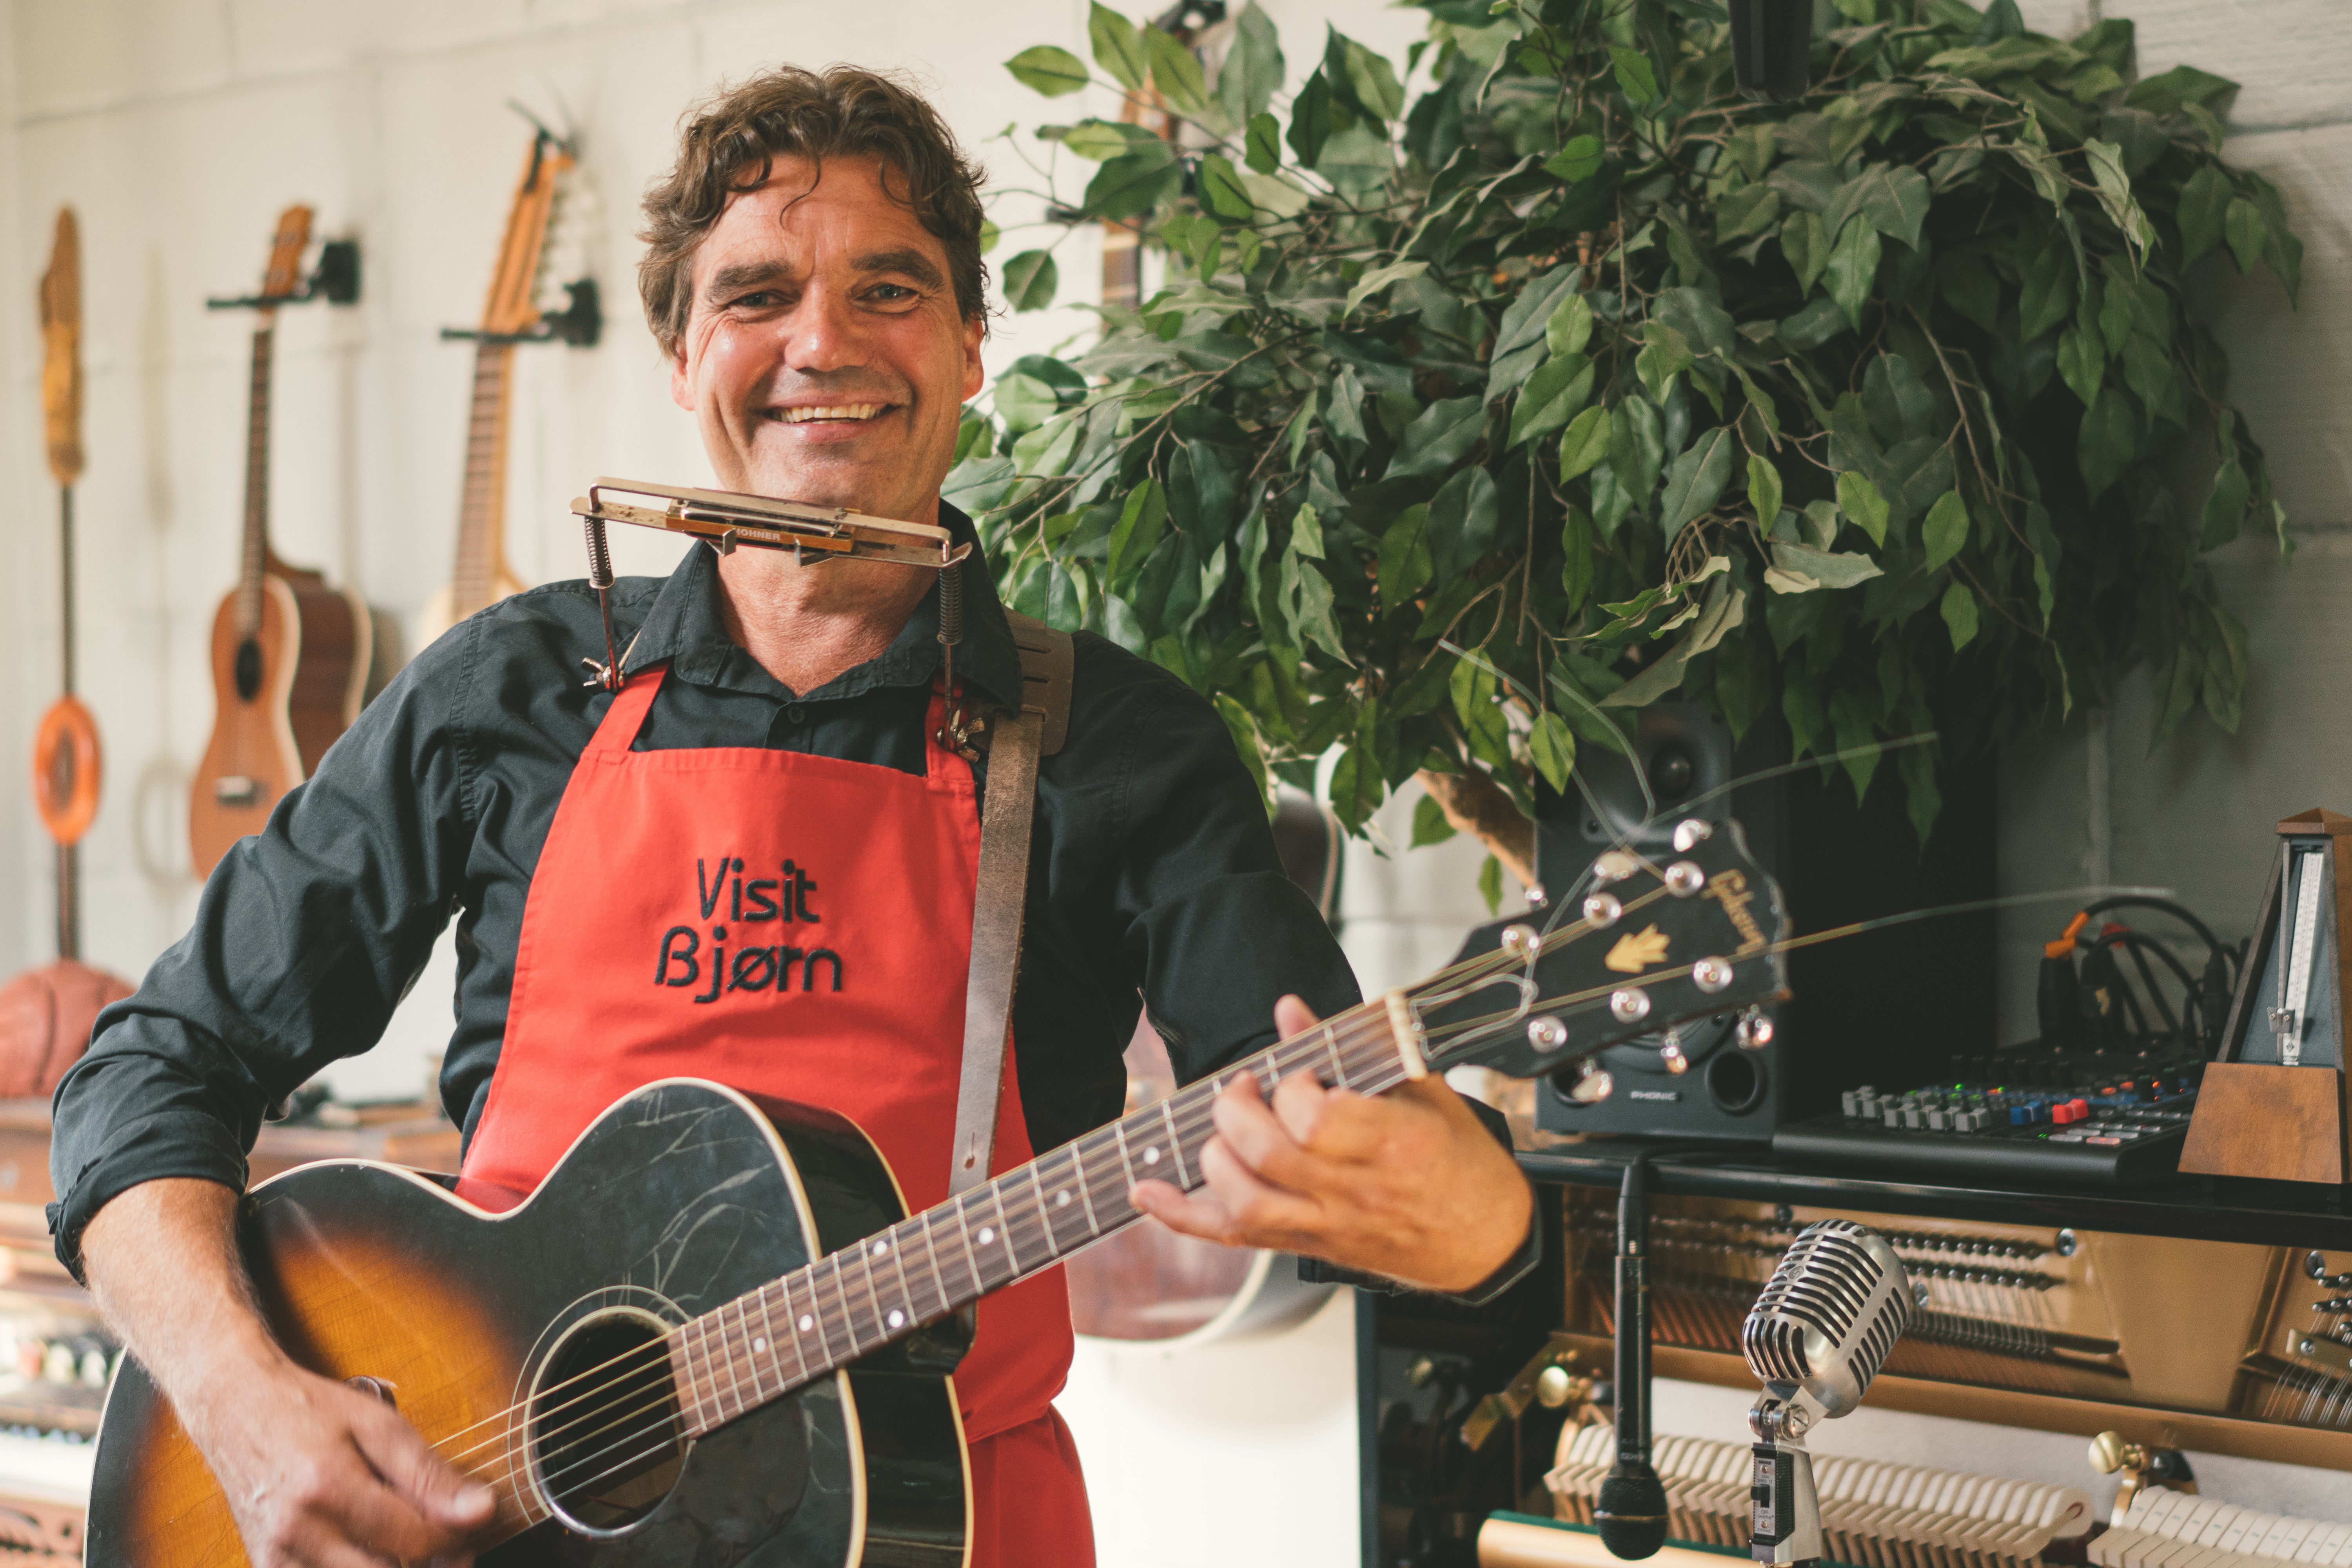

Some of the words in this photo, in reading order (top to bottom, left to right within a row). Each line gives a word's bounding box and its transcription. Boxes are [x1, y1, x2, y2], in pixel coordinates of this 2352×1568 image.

[698, 857, 819, 923] Visit
[654, 926, 842, 1004] Bjørn
[1631, 1091, 1676, 1101] PHONIC
